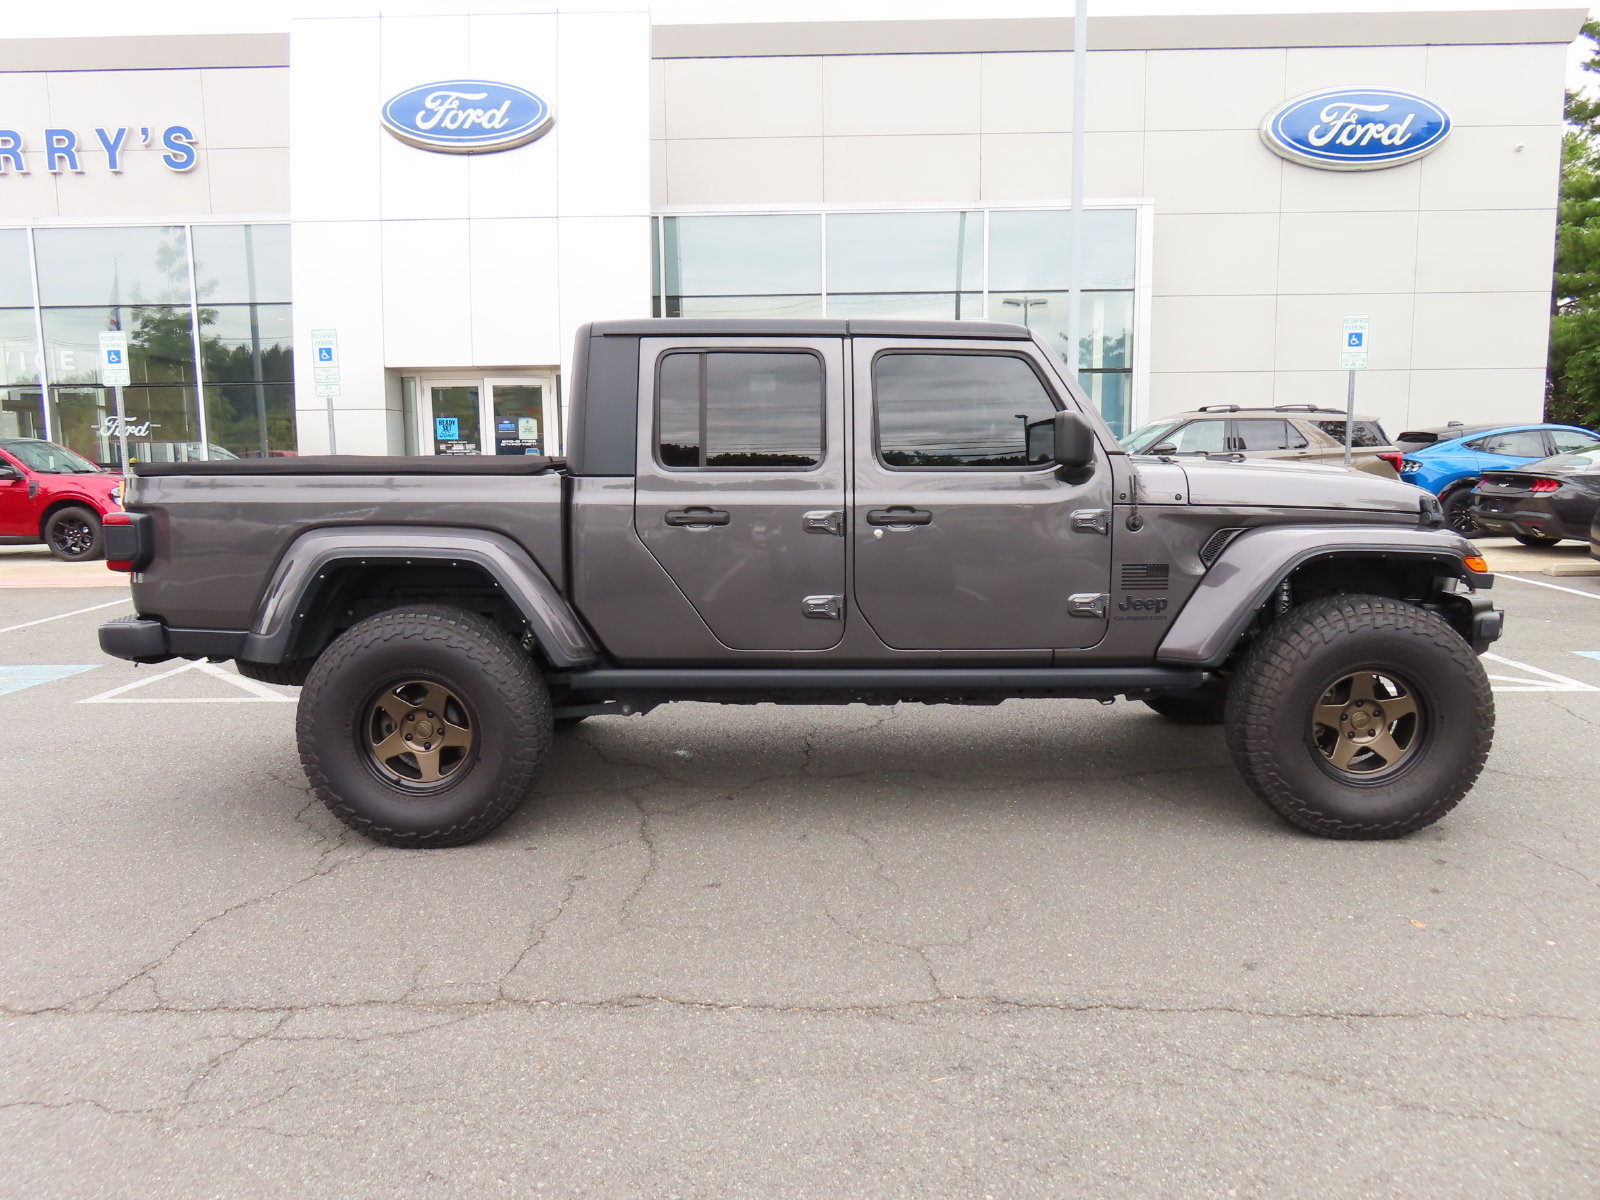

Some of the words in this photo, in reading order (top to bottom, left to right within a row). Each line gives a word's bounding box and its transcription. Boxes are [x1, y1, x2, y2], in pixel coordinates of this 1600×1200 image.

[415, 91, 512, 130] Ford
[1308, 102, 1416, 147] Ford
[100, 416, 150, 436] Ford
[1119, 594, 1168, 613] Jeep
